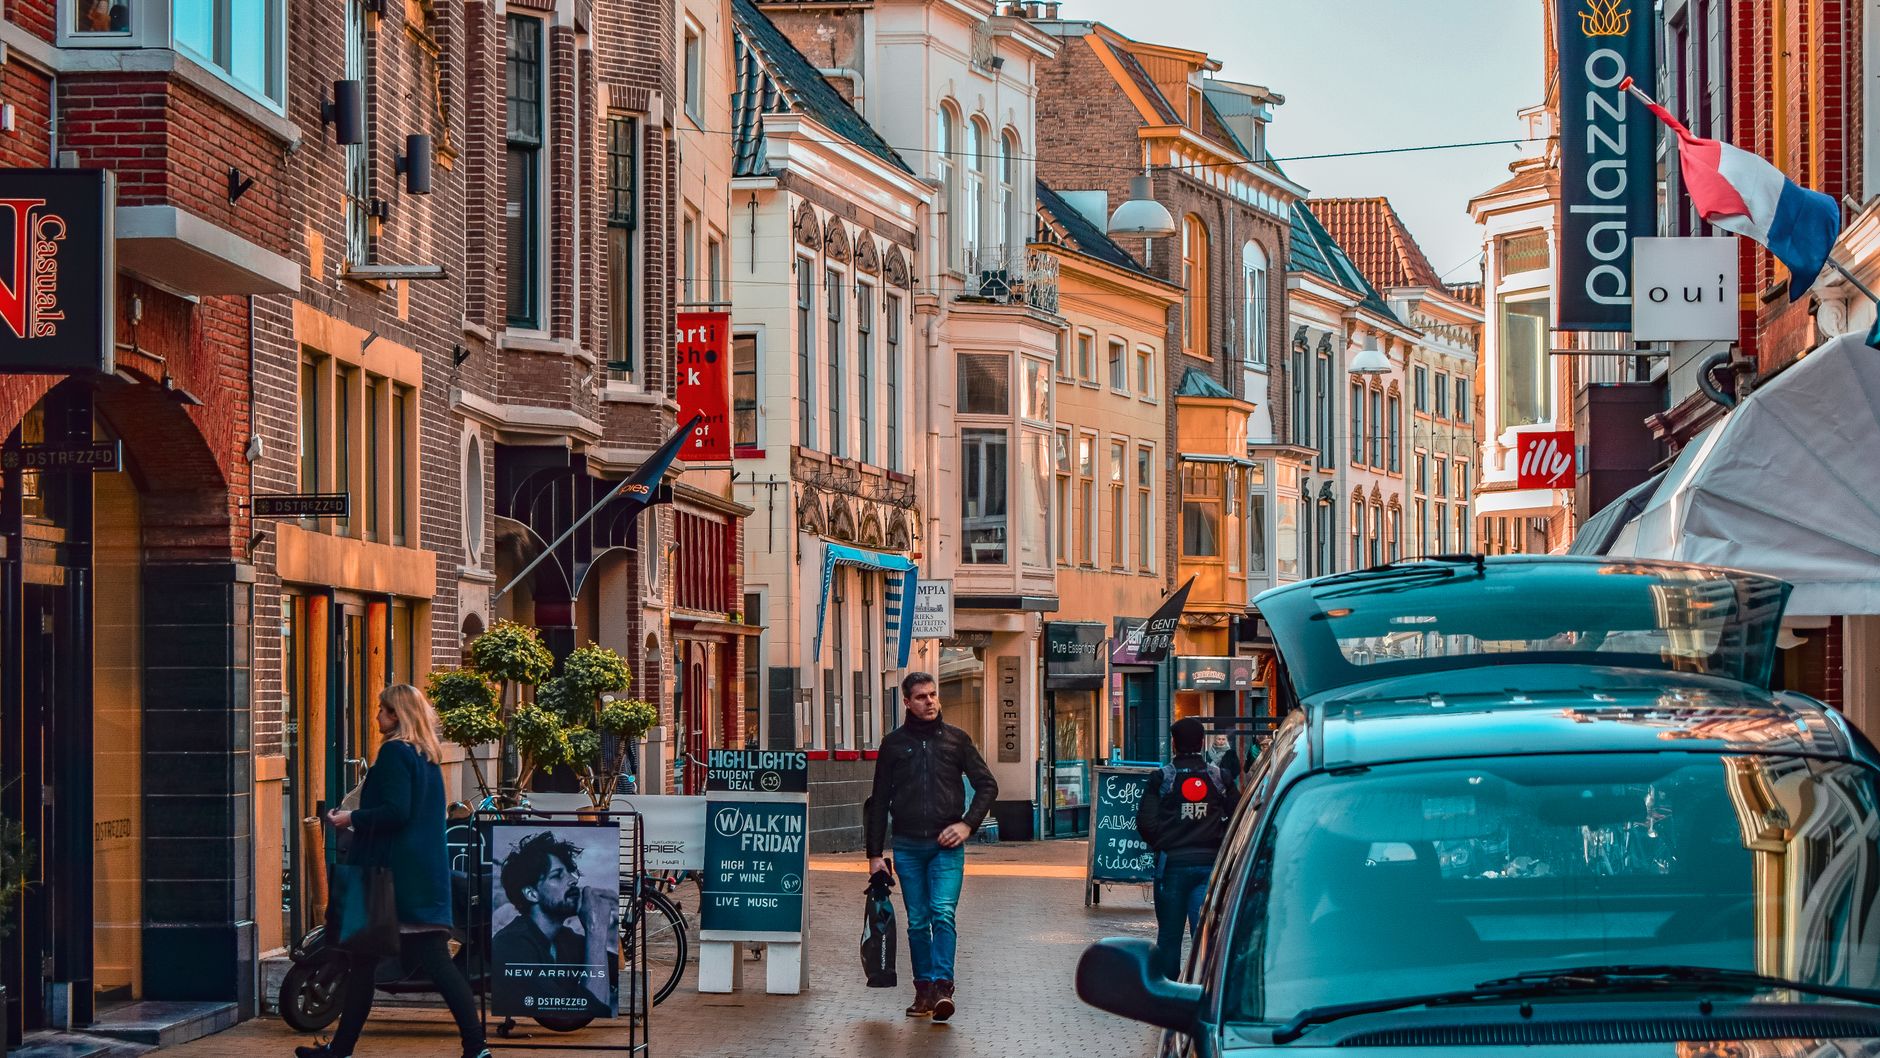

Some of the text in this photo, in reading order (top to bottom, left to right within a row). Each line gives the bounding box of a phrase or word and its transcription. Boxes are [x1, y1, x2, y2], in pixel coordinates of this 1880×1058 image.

[1569, 48, 1632, 305] palazzo
[36, 214, 67, 337] Casuals
[695, 425, 709, 436] of
[695, 437, 715, 448] art
[26, 449, 112, 465] DSTREZZED
[1520, 438, 1572, 485] illy
[275, 500, 344, 512] DSTREZZED
[1052, 640, 1067, 654] Pure
[708, 769, 755, 780] STUDENT
[728, 779, 755, 791] DEAL
[1098, 815, 1137, 831] ALW
[741, 833, 802, 853] FRIDAY
[720, 860, 773, 871] HIGH TEA
[720, 873, 766, 883] OF WINE
[715, 897, 779, 908] LIVE MUSIC
[504, 969, 606, 978] NEW ARRIVALS
[537, 997, 588, 1007] DSTREZZED
